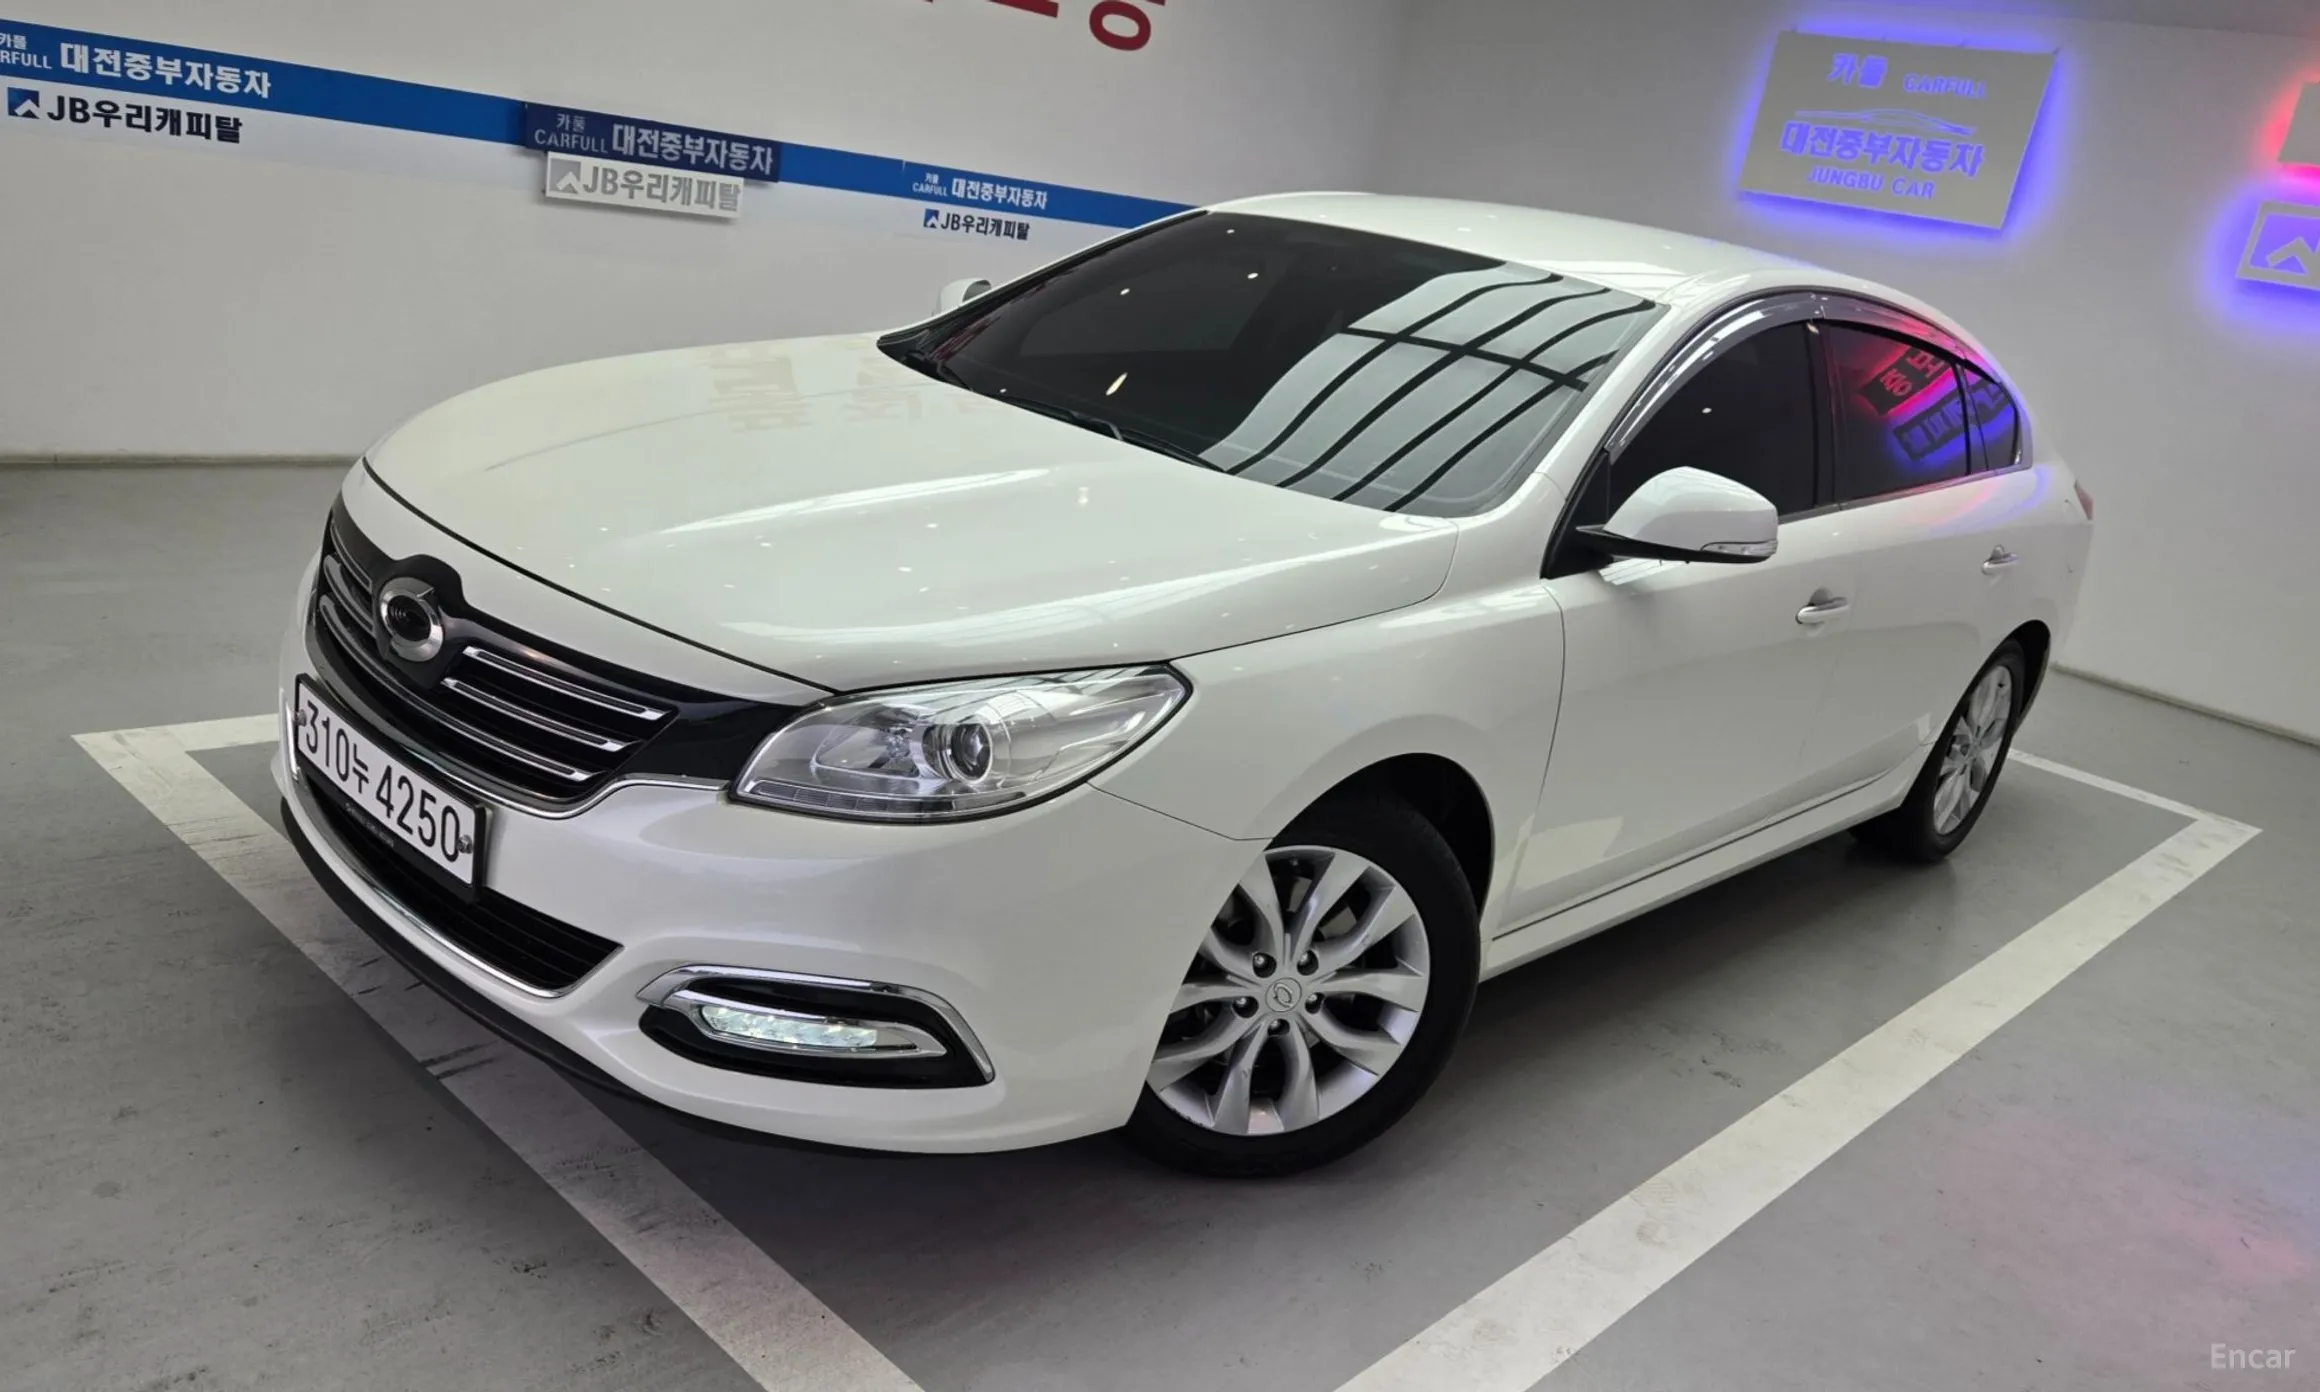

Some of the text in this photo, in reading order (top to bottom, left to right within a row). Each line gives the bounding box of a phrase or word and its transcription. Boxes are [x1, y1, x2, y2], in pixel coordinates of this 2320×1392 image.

[0, 42, 271, 99] RFULL 대전중부자동차
[1902, 73, 1986, 99] CARFULL
[47, 95, 243, 144] JB우리캐피탈
[534, 123, 773, 175] CARFULL 대전중부자동차
[1780, 120, 1985, 177] 대전중부자동차
[583, 166, 741, 212] JB우리캐피탈
[912, 178, 1048, 210] CARFULL 대전중부자동차
[1806, 166, 1936, 199] JUNGBU CAR
[941, 212, 1030, 241] JB우리캐피탈
[305, 699, 369, 794] 310누
[376, 764, 461, 863] 4250
